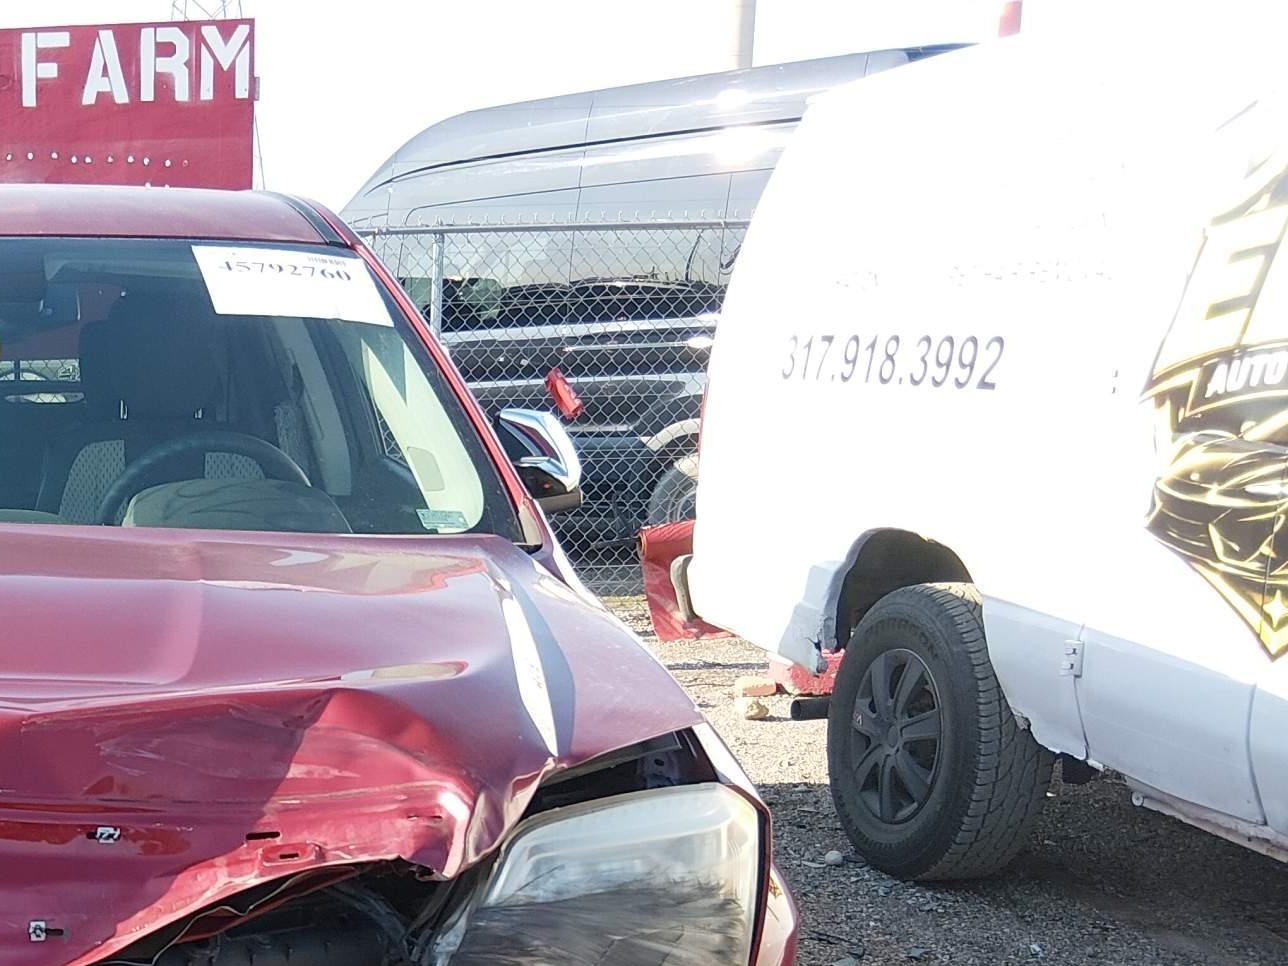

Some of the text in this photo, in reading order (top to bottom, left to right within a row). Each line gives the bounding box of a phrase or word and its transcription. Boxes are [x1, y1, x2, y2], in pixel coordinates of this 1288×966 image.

[21, 24, 251, 107] FARM
[218, 261, 352, 282] 45792760
[781, 334, 1005, 390] 317.918.3992
[1205, 350, 1288, 398] AUTO
